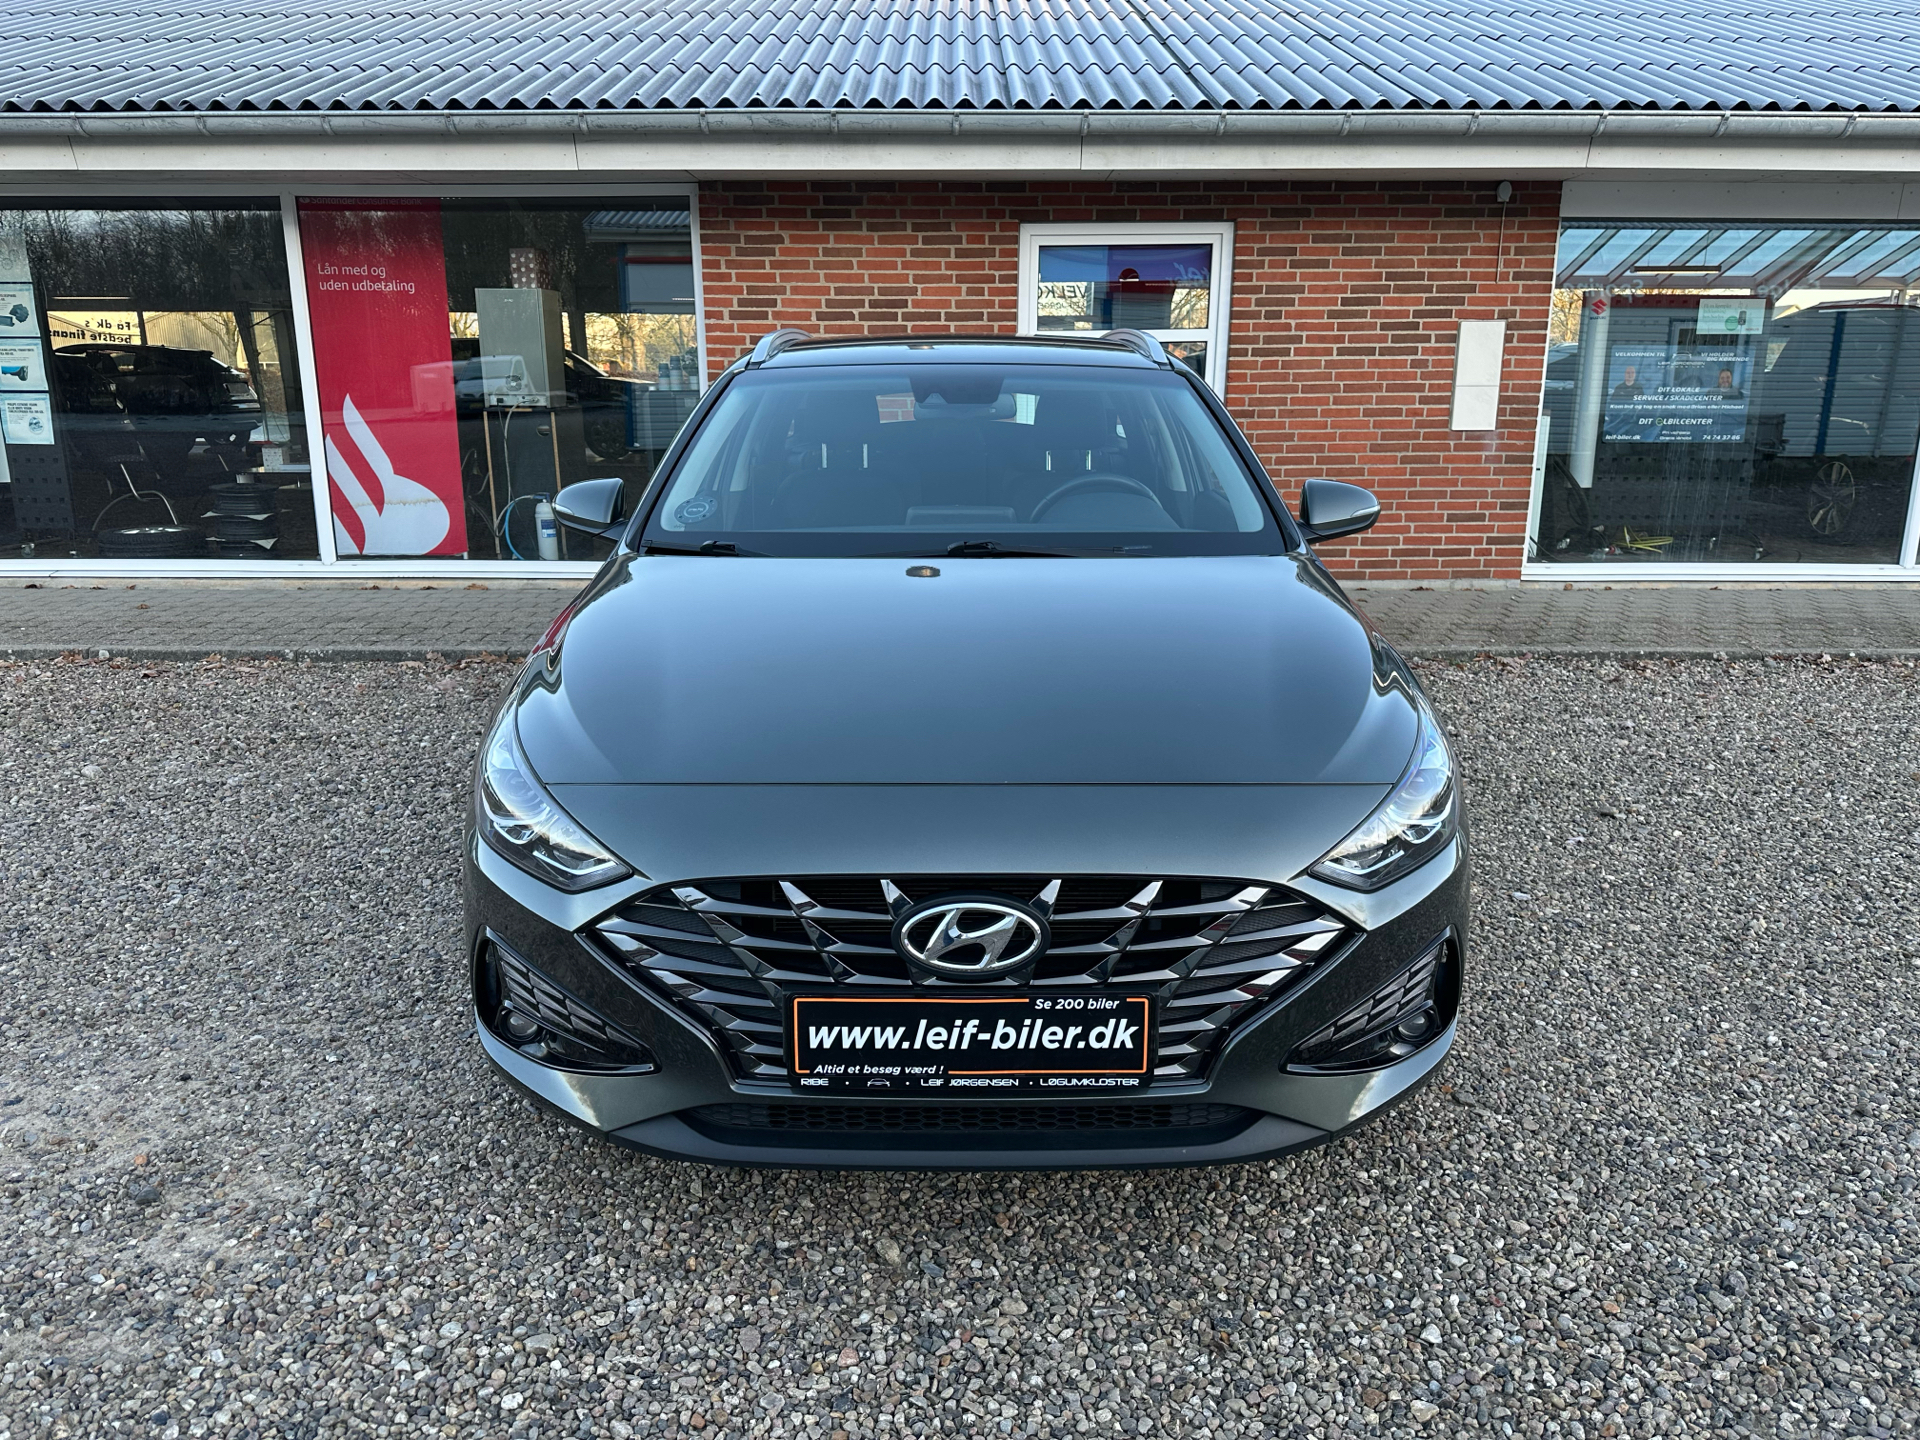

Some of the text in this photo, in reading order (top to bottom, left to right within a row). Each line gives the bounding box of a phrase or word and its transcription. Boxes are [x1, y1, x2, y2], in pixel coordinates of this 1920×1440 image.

[318, 262, 386, 278] Lån med og
[319, 279, 415, 294] uden udbetaling
[1034, 998, 1119, 1010] Se 200 biler
[808, 1018, 1140, 1050] www.leif-biler.dk
[813, 1064, 845, 1074] Altid
[847, 1065, 861, 1074] et
[863, 1064, 901, 1076] besøg
[903, 1064, 936, 1074] værd
[800, 1078, 1139, 1087] RIBE LEIF JØRGENSEN LØGUMKLOSTER
